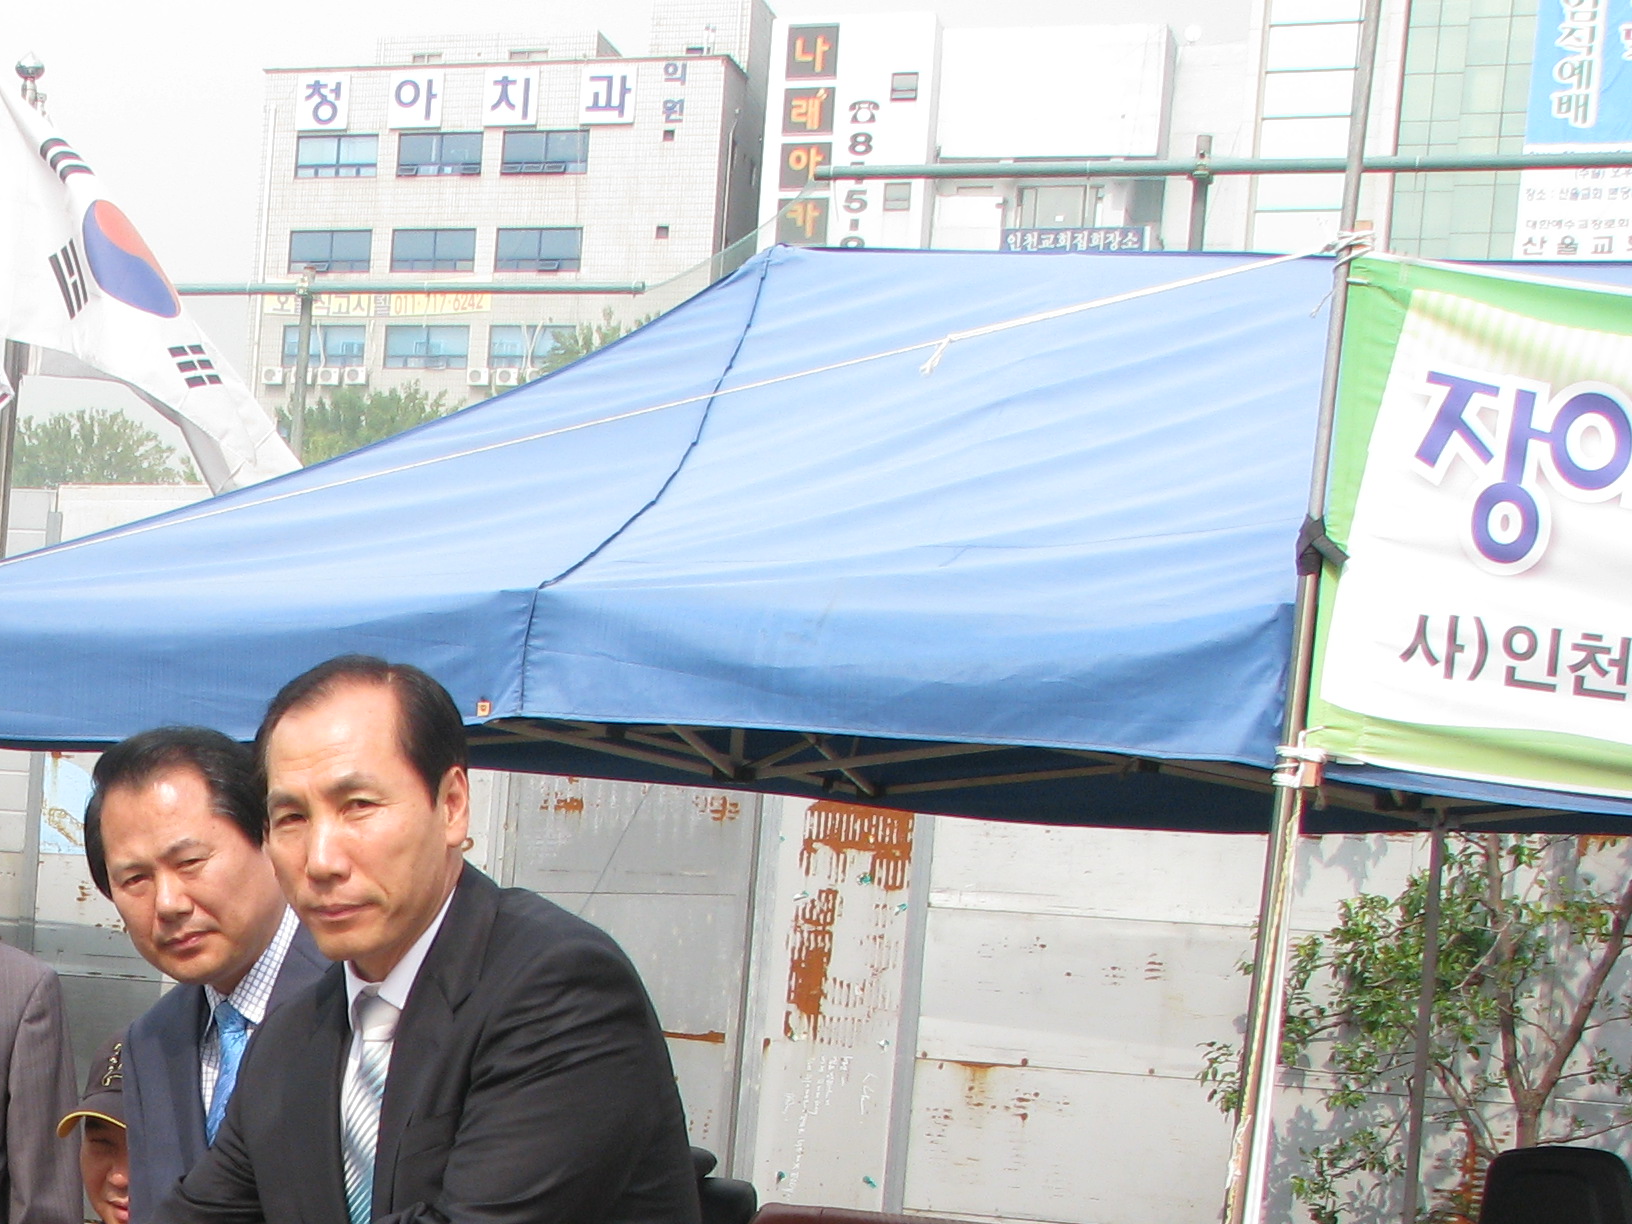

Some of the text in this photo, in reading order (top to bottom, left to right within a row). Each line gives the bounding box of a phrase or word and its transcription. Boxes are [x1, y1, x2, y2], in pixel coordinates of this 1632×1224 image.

[304, 75, 632, 125] 청아치과
[663, 62, 688, 124] 의원
[1522, 235, 1632, 256] 산울교
